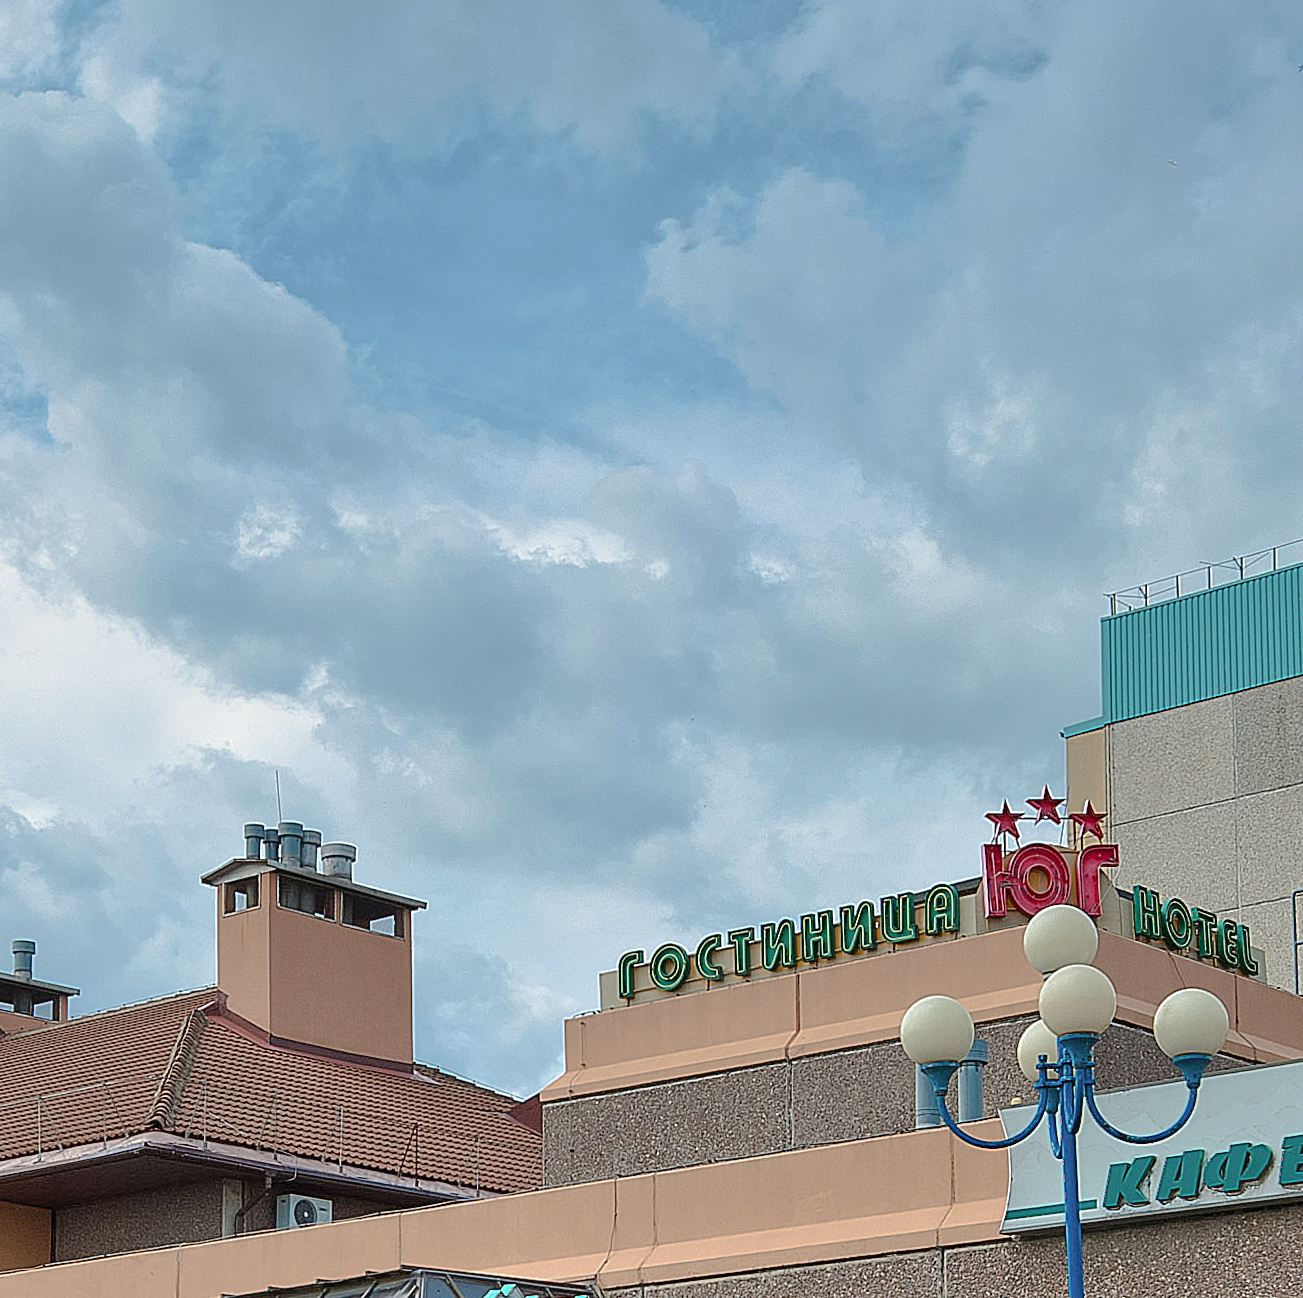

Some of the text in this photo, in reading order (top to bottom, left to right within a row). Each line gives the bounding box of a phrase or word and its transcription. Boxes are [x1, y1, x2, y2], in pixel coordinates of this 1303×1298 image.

[617, 842, 1120, 999] ГОСТИНИЦА ЮГ
[1132, 884, 1259, 976] HOTEL
